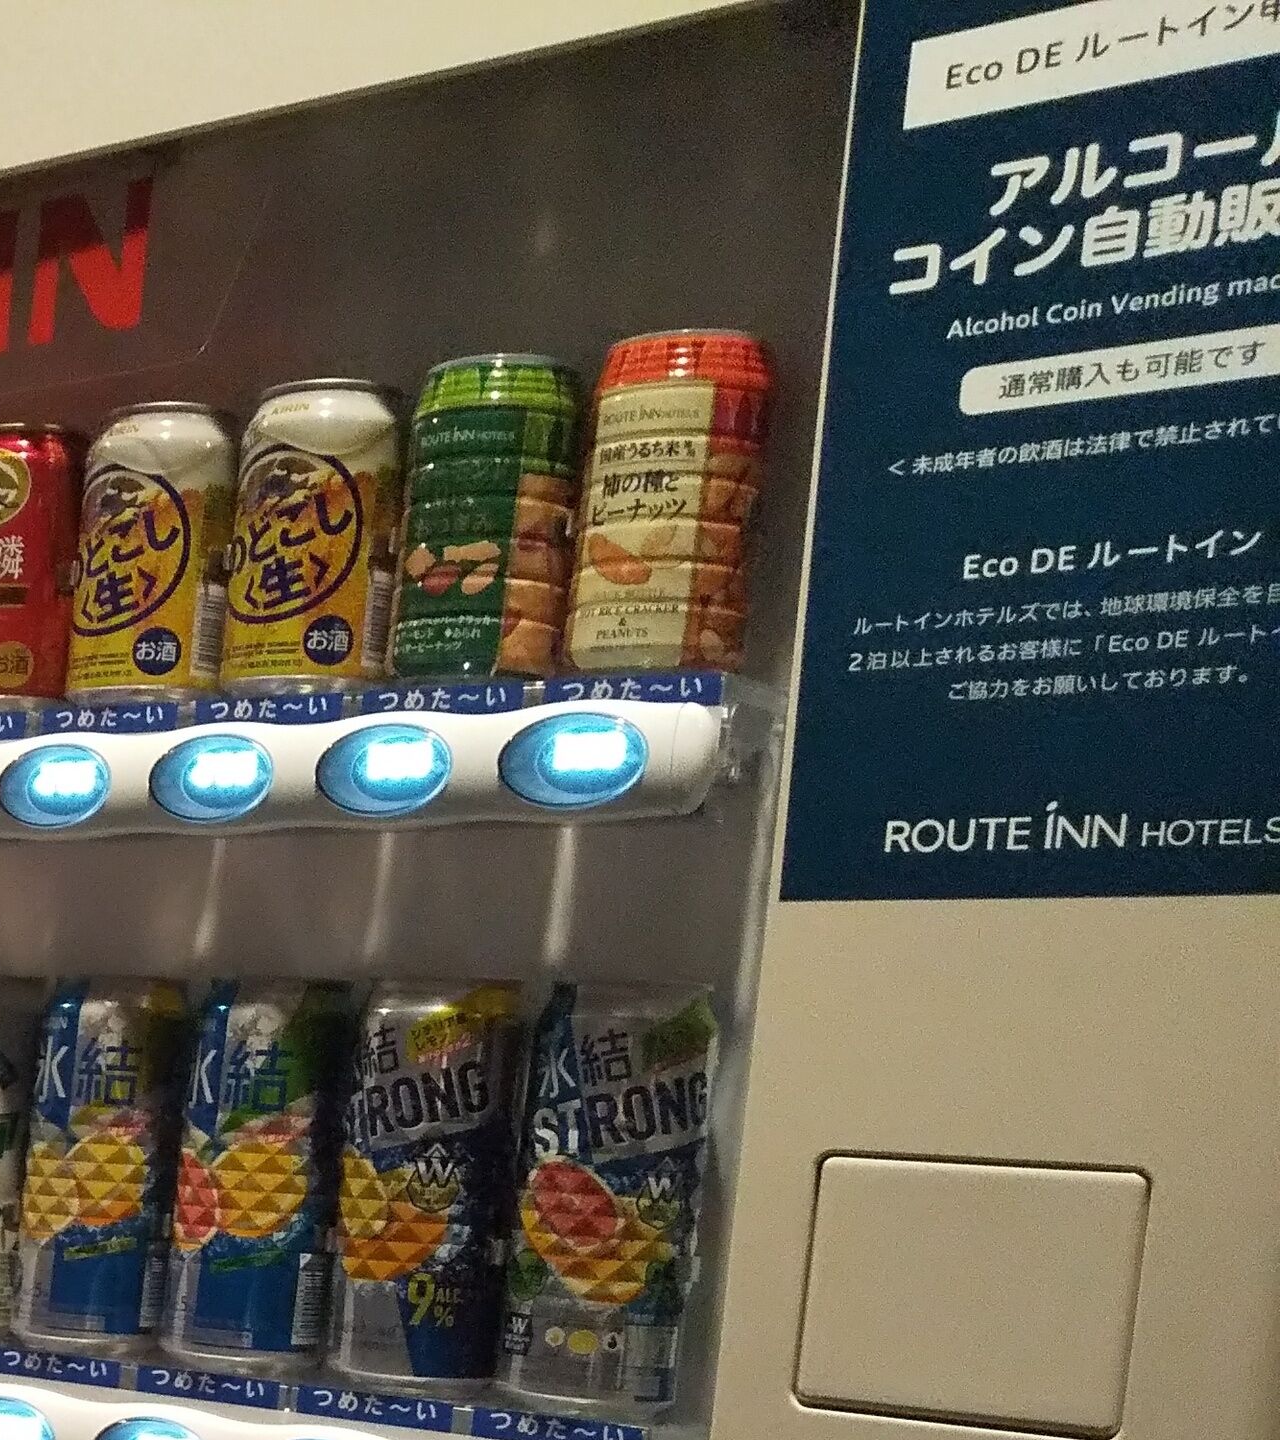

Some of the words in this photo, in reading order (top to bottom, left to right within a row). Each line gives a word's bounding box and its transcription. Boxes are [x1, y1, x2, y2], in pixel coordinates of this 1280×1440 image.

[945, 62, 1003, 90] Eco
[1016, 40, 1062, 76] DE
[946, 308, 1040, 341] Alcohol
[1046, 301, 1103, 326] Coin
[1111, 280, 1219, 316] Vending
[998, 340, 1267, 401] 通常購入も可能です
[601, 468, 681, 499] 柿の種と
[590, 499, 688, 526] ピーナッツ
[962, 552, 1018, 580] Eco
[1030, 545, 1077, 574] DE
[1086, 528, 1263, 570] ルートイン
[135, 637, 178, 664] お酒
[306, 626, 350, 655] お酒
[595, 627, 650, 641] PEANUTS
[947, 663, 1249, 701] ご協力をお願いしております。
[883, 815, 1033, 855] ROUTE
[1140, 815, 1280, 848] HOTELS
[539, 1029, 633, 1100] 氷結
[532, 1072, 712, 1160] STRONG
